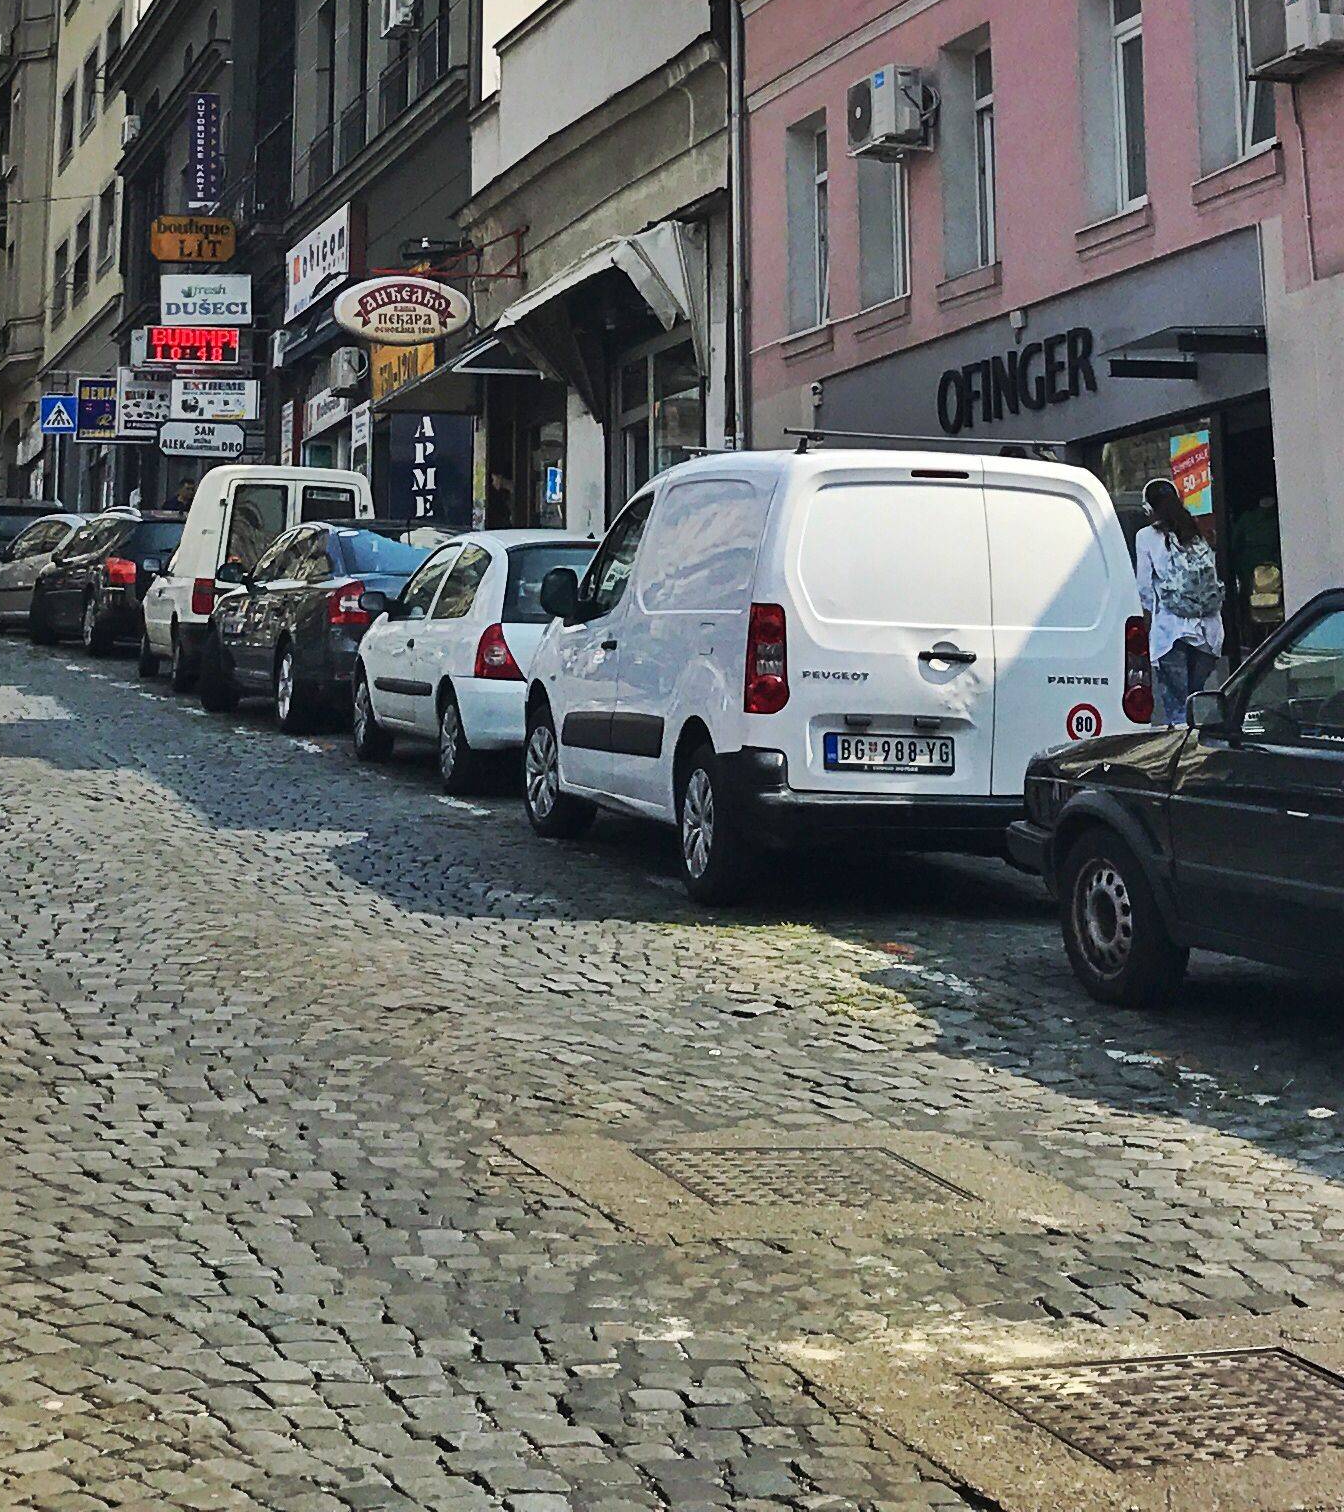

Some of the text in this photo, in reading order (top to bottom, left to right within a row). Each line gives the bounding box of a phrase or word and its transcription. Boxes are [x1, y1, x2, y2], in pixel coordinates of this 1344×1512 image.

[196, 98, 206, 198] AUTOBUSKE KARTE
[157, 219, 230, 239] boutique
[178, 240, 222, 257] LIT
[165, 299, 248, 316] DUŠECI
[155, 347, 223, 362] 10:48
[182, 382, 246, 391] EXTREME
[938, 327, 1097, 434] OFINGER
[194, 426, 216, 436] SAN
[161, 438, 186, 450] ALEK
[221, 441, 243, 453] DRO
[802, 670, 870, 681] PEUGEOT
[1047, 675, 1109, 686] PARTNER
[1075, 715, 1093, 733] 80
[841, 739, 865, 761] BG
